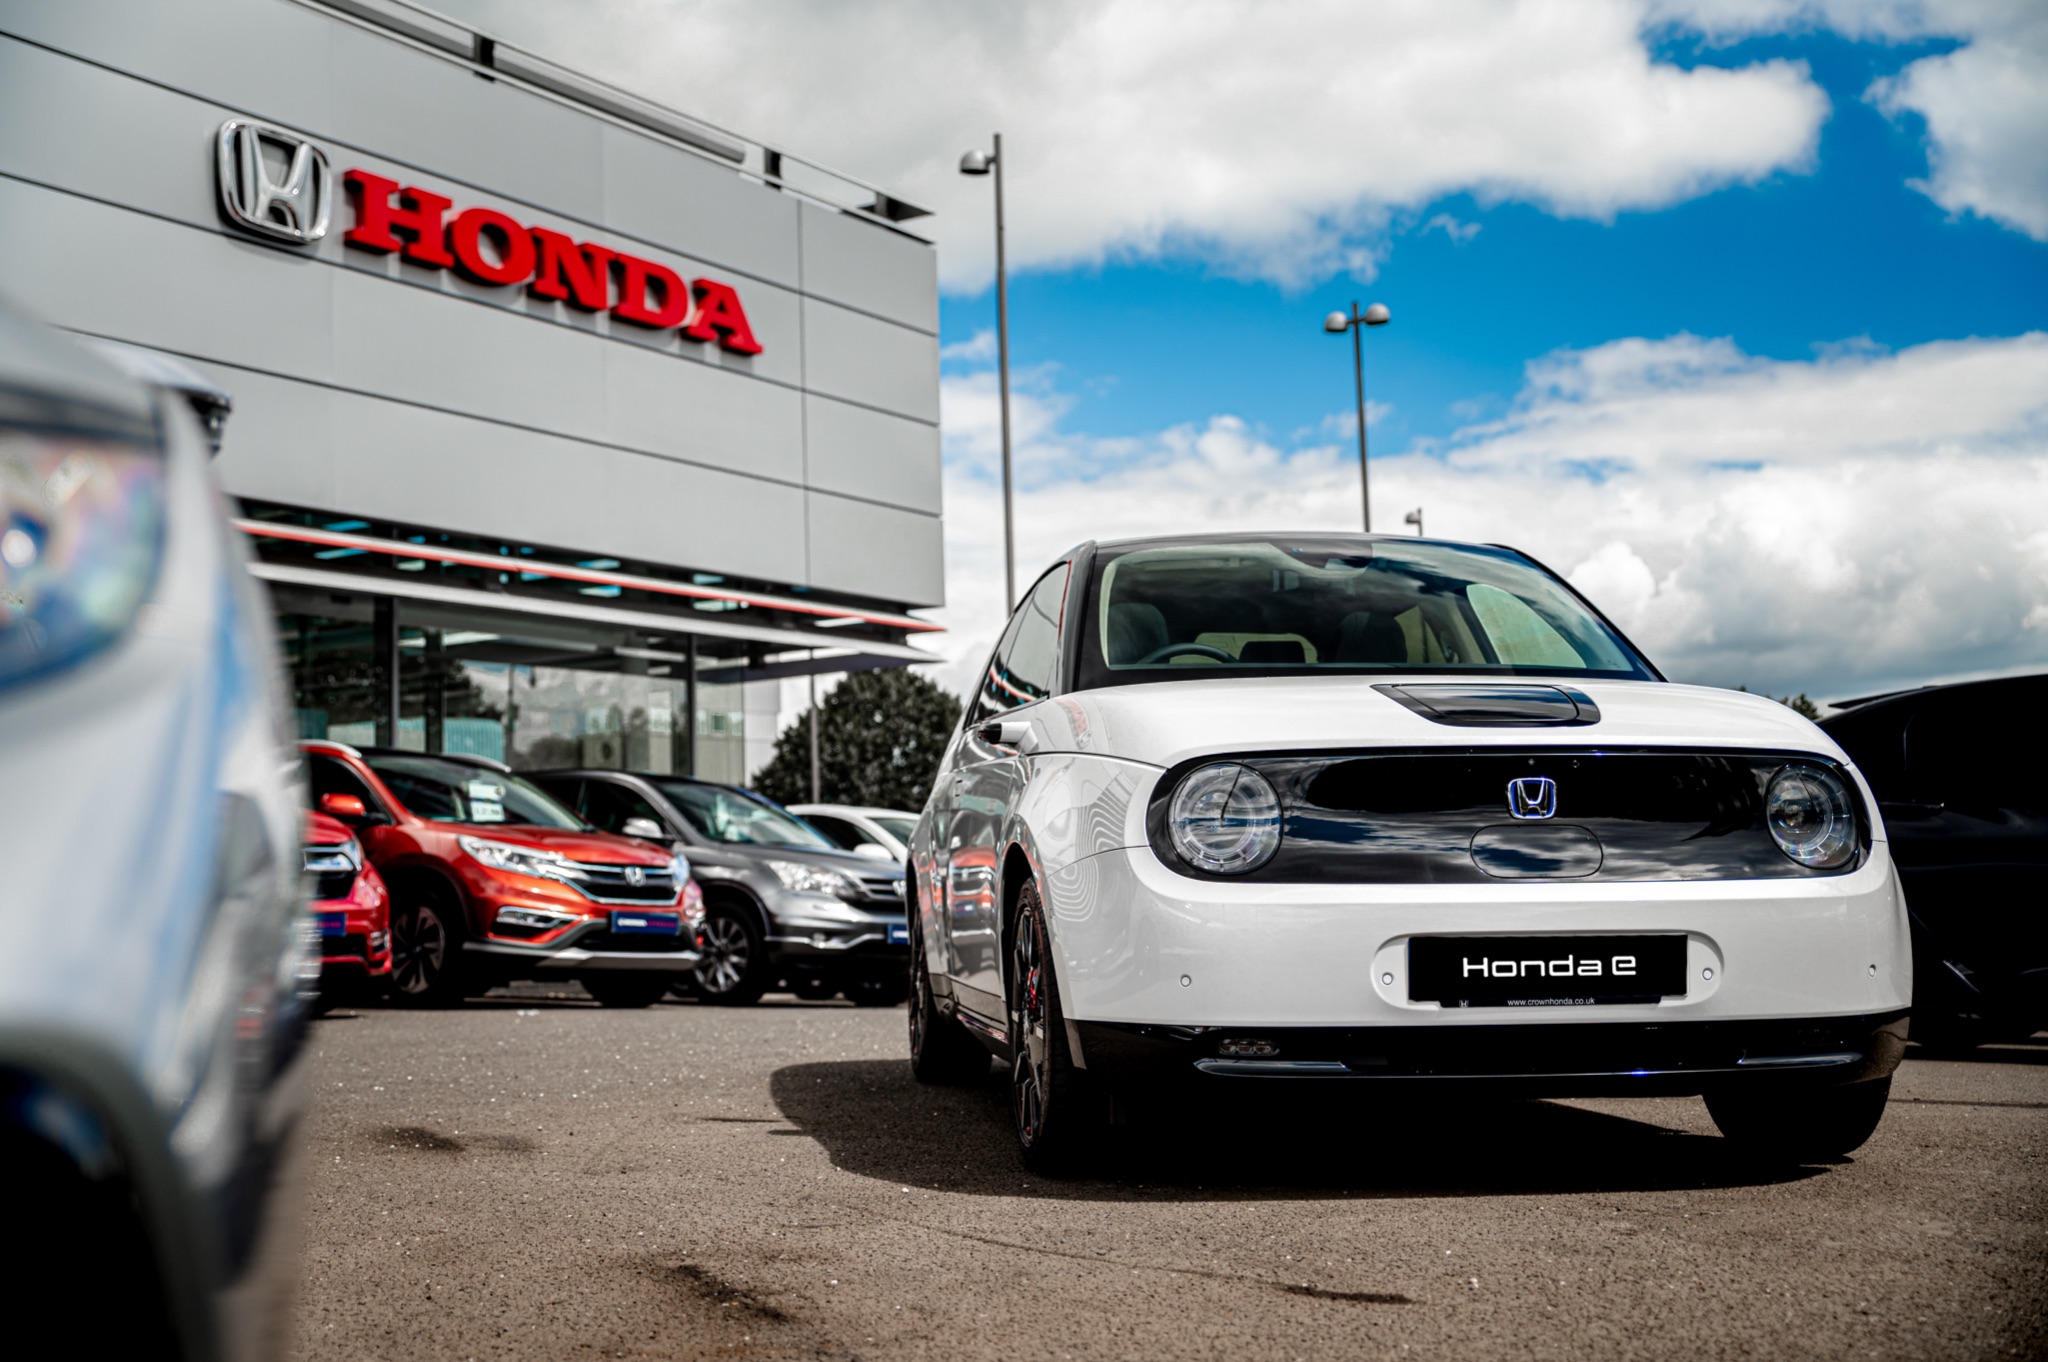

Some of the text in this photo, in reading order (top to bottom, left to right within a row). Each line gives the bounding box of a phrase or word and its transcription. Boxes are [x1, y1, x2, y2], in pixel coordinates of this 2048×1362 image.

[344, 168, 764, 355] HONDA
[1462, 954, 1603, 978] Honda
[1507, 997, 1595, 1006] www.crownhonda.co.uk
